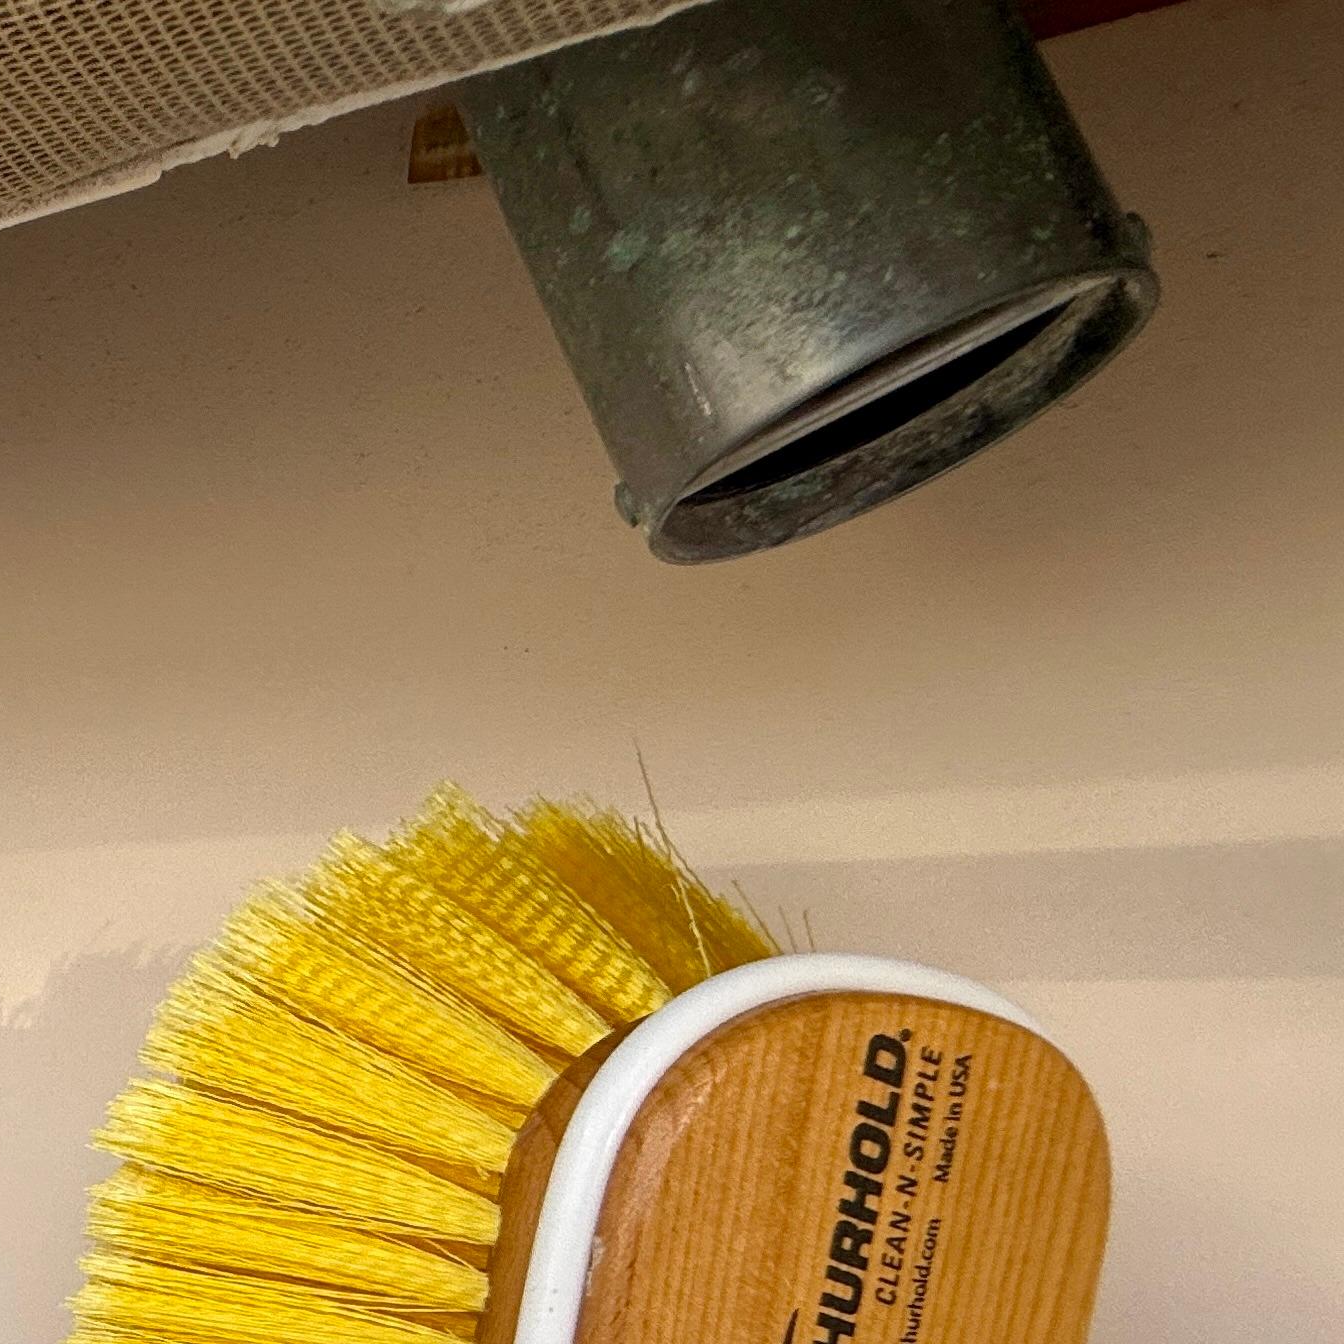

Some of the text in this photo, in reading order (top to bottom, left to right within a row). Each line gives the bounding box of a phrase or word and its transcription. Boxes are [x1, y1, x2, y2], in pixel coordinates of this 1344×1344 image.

[875, 1045, 943, 1306] CLEAN-N-SIMPLE
[932, 1126, 959, 1183] Made
[949, 1054, 972, 1097] USA
